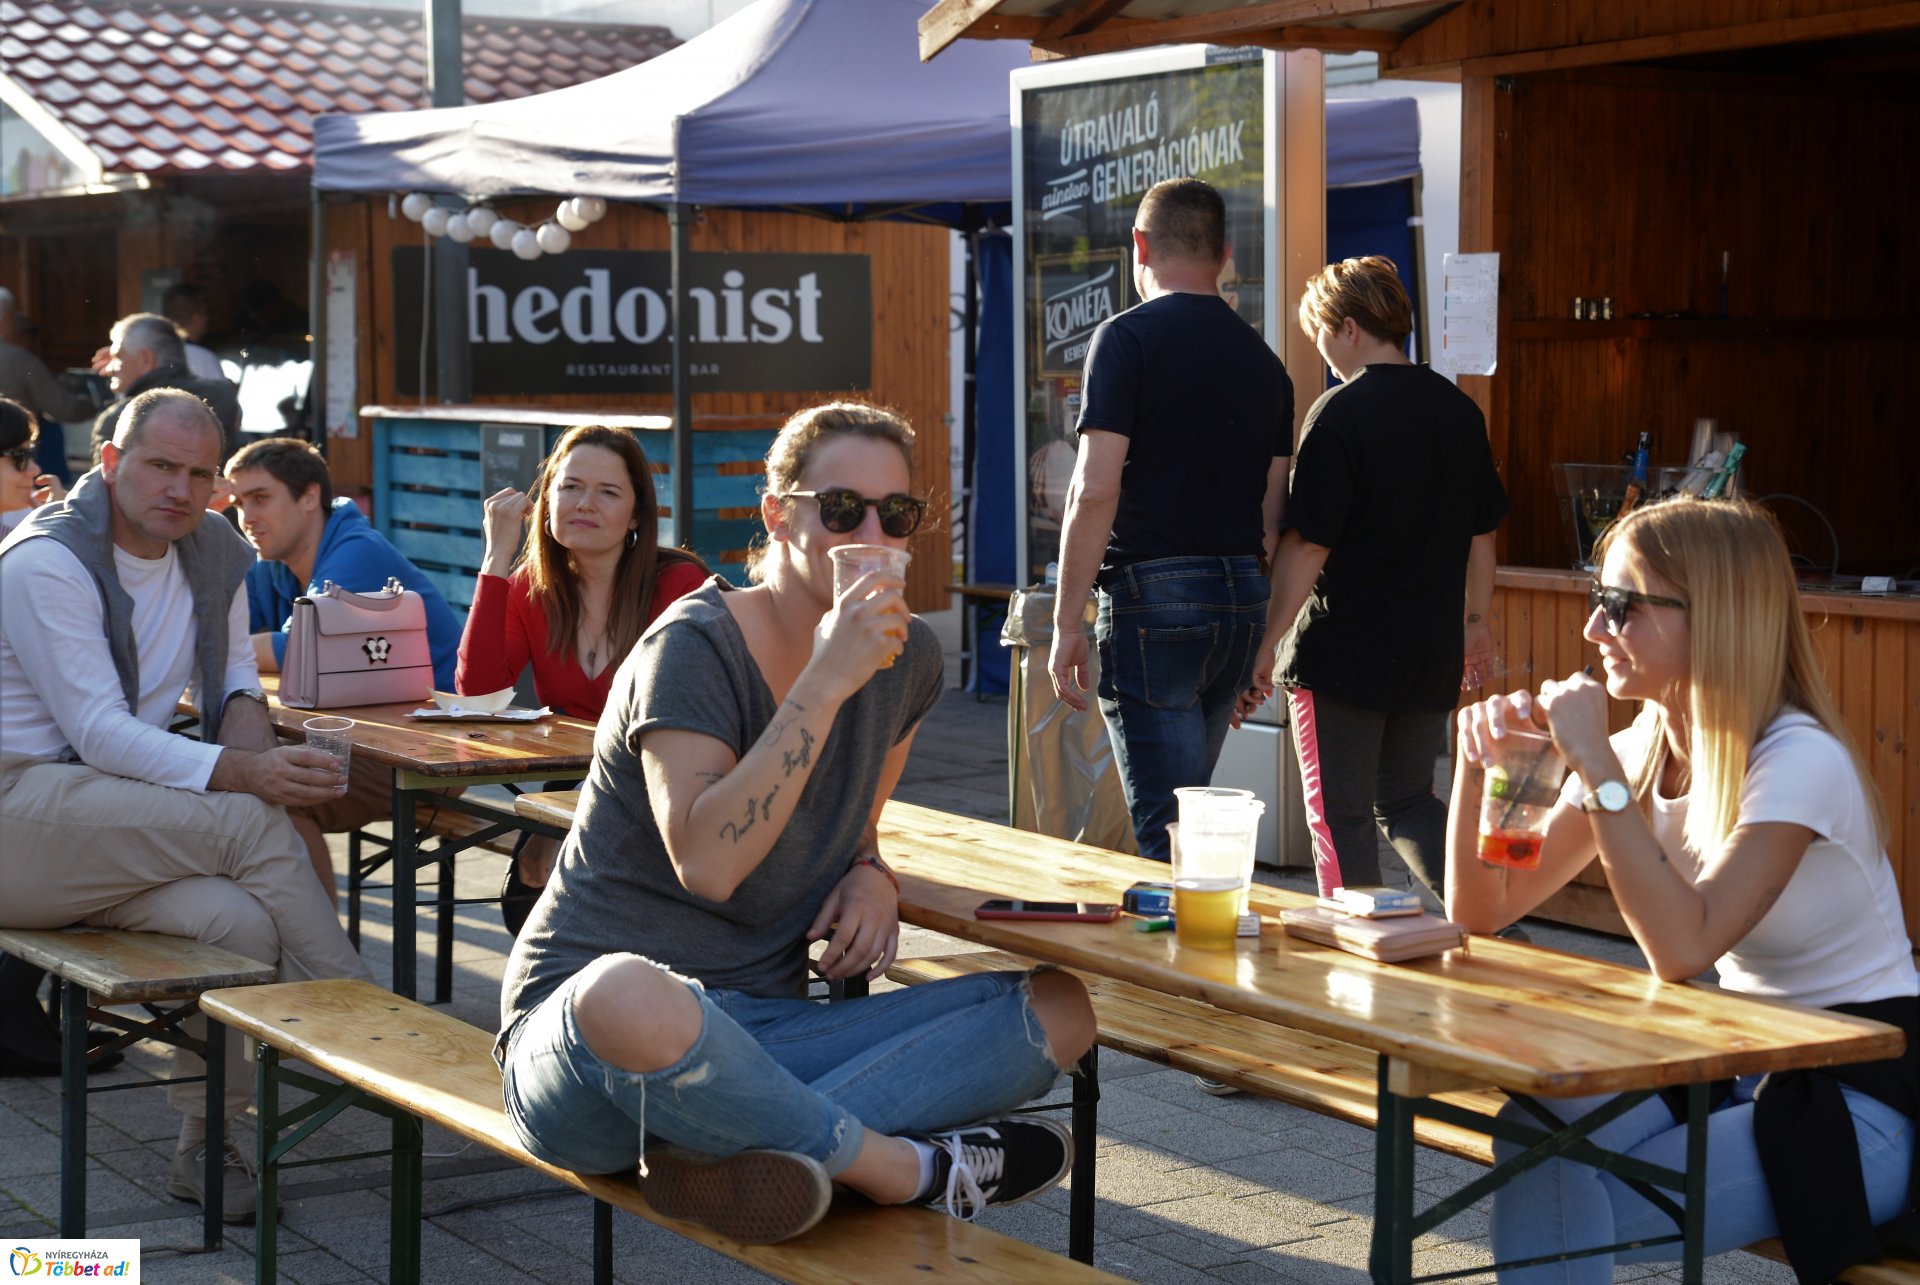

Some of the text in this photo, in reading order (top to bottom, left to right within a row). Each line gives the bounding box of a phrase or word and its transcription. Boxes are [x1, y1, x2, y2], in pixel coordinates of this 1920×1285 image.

[1042, 120, 1244, 211] minden GENERÁCIÓNAK
[1060, 92, 1159, 166] ÚTRAVALÓ
[467, 267, 823, 344] hedonist
[1045, 286, 1114, 340] KOMÉTA
[566, 363, 720, 377] RESTAURANT BAR
